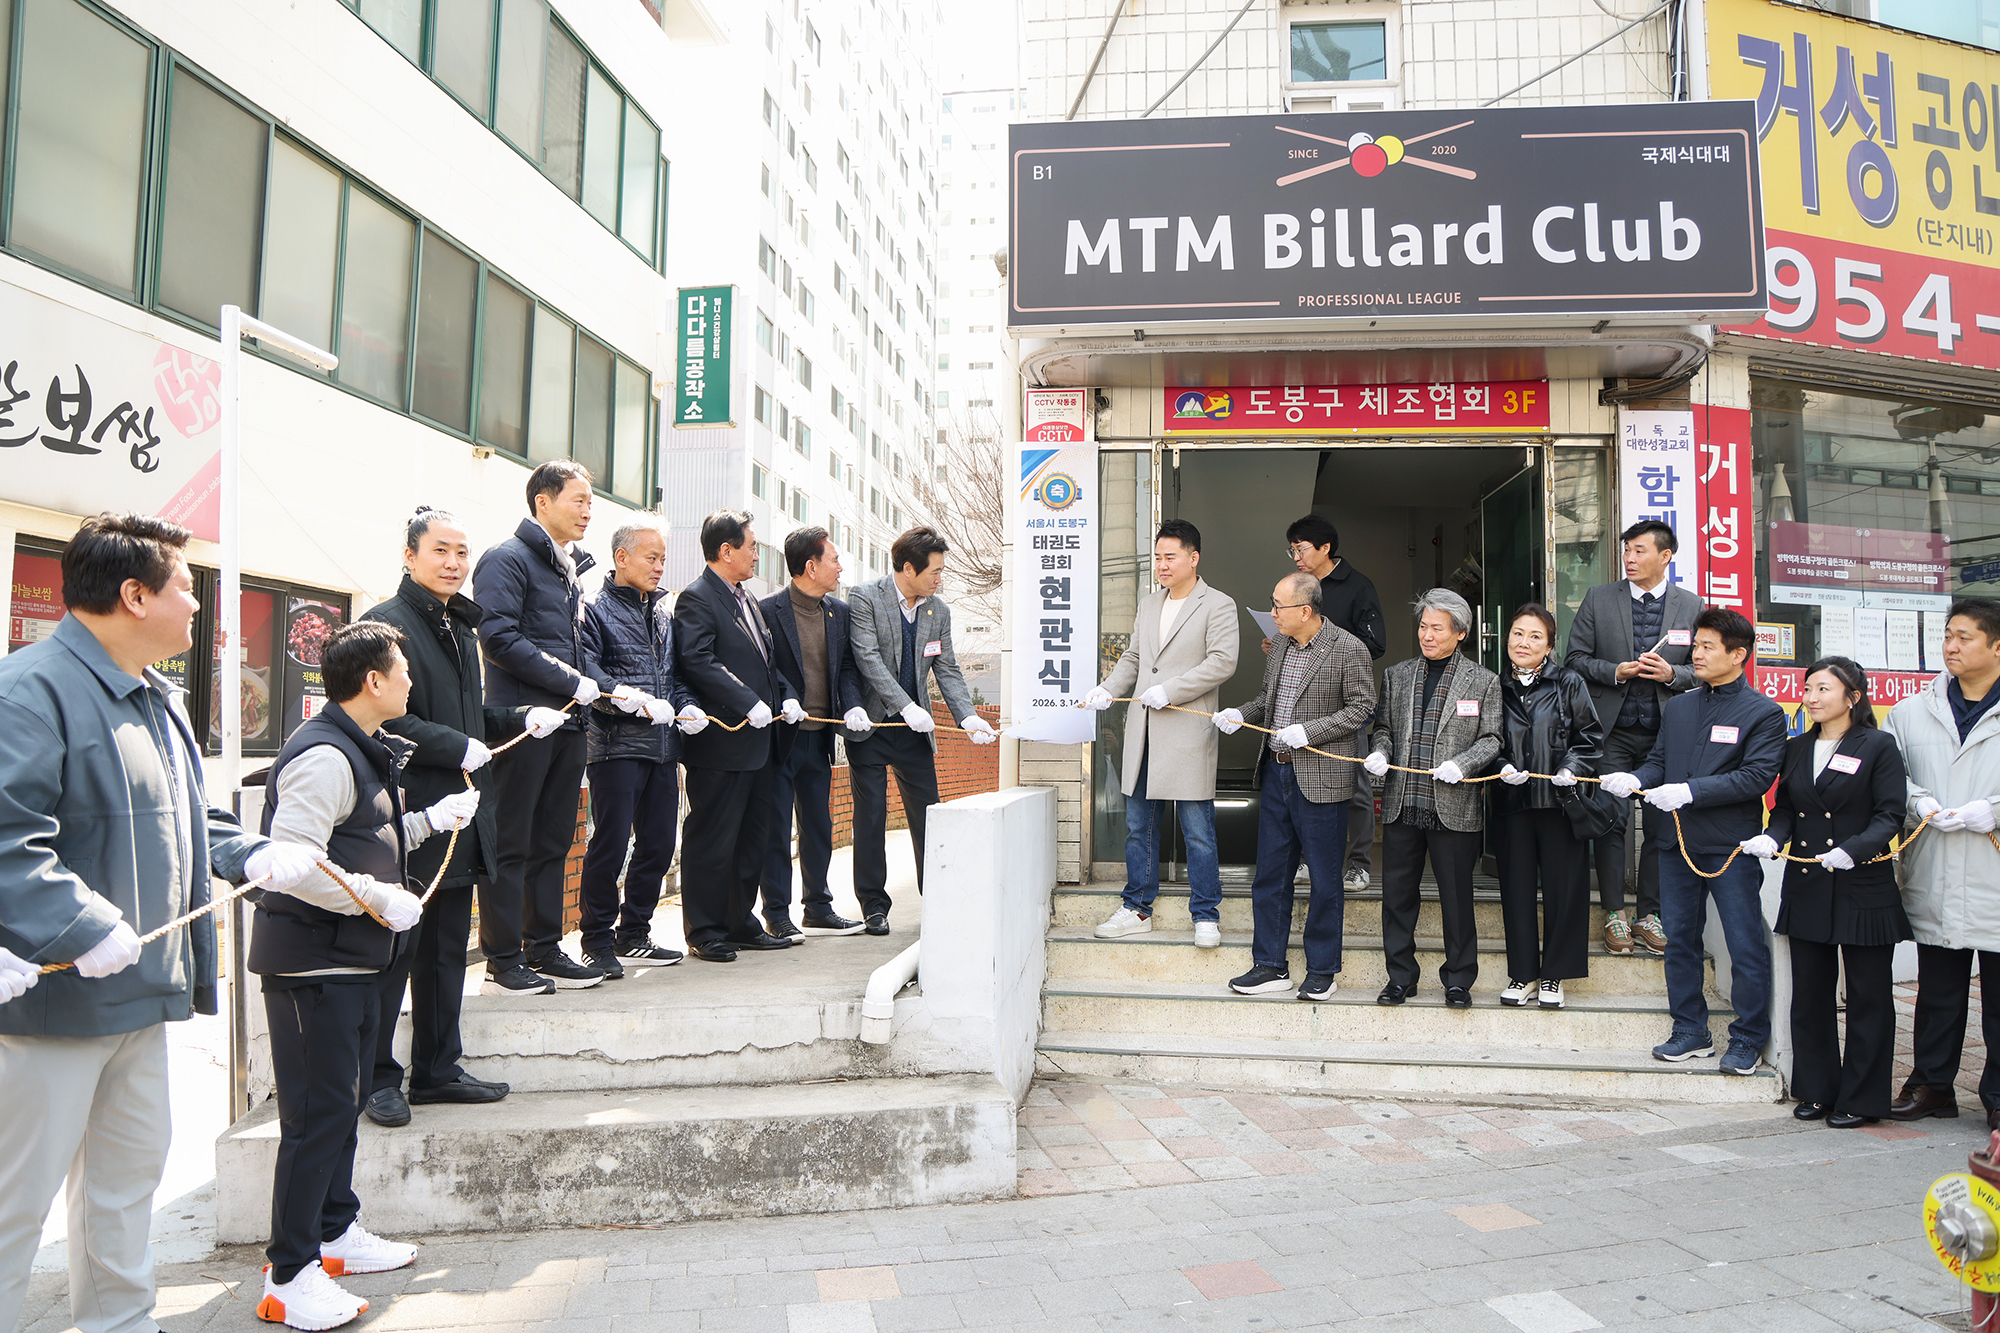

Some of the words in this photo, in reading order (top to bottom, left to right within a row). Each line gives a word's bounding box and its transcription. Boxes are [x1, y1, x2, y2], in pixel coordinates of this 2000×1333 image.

[1737, 32, 1899, 229] 거성
[1288, 149, 1318, 159] SINCE
[1431, 145, 1457, 156] 2020
[1642, 145, 1731, 165] 국제식대대
[1032, 165, 1053, 181] B1
[1064, 215, 1235, 275] MTM
[1264, 204, 1503, 269] Billard
[1531, 201, 1701, 263] Club
[1917, 217, 1993, 256] (단지내)
[1298, 294, 1404, 307] PROFESSIONAL
[1407, 292, 1462, 305] LEAGUE
[683, 295, 707, 420] 다다름공작소
[1245, 386, 1344, 423] 도봉구
[1358, 382, 1490, 420] 체조협회
[1502, 389, 1536, 414] 3F
[1038, 430, 1073, 442] CCTV
[1626, 424, 1689, 436] 기독교
[1626, 438, 1689, 451] 대한성결교회
[1050, 484, 1065, 498] 축
[162, 503, 182, 522] orean
[179, 487, 195, 507] Food
[1026, 518, 1055, 528] 서울시
[1058, 518, 1088, 528] 도봉구
[1032, 535, 1081, 551] 태권도
[1040, 554, 1072, 570] 협회
[1776, 554, 1799, 564] 방학역과
[1800, 555, 1826, 566] 도봉구청의
[1870, 560, 1891, 570] 방학역과
[1892, 562, 1917, 572] 도봉구청의
[12, 583, 52, 601] 마늘보쌈
[1038, 575, 1073, 693] 현판식
[302, 671, 325, 684] 직화불
[1032, 699, 1057, 707] 2026.
